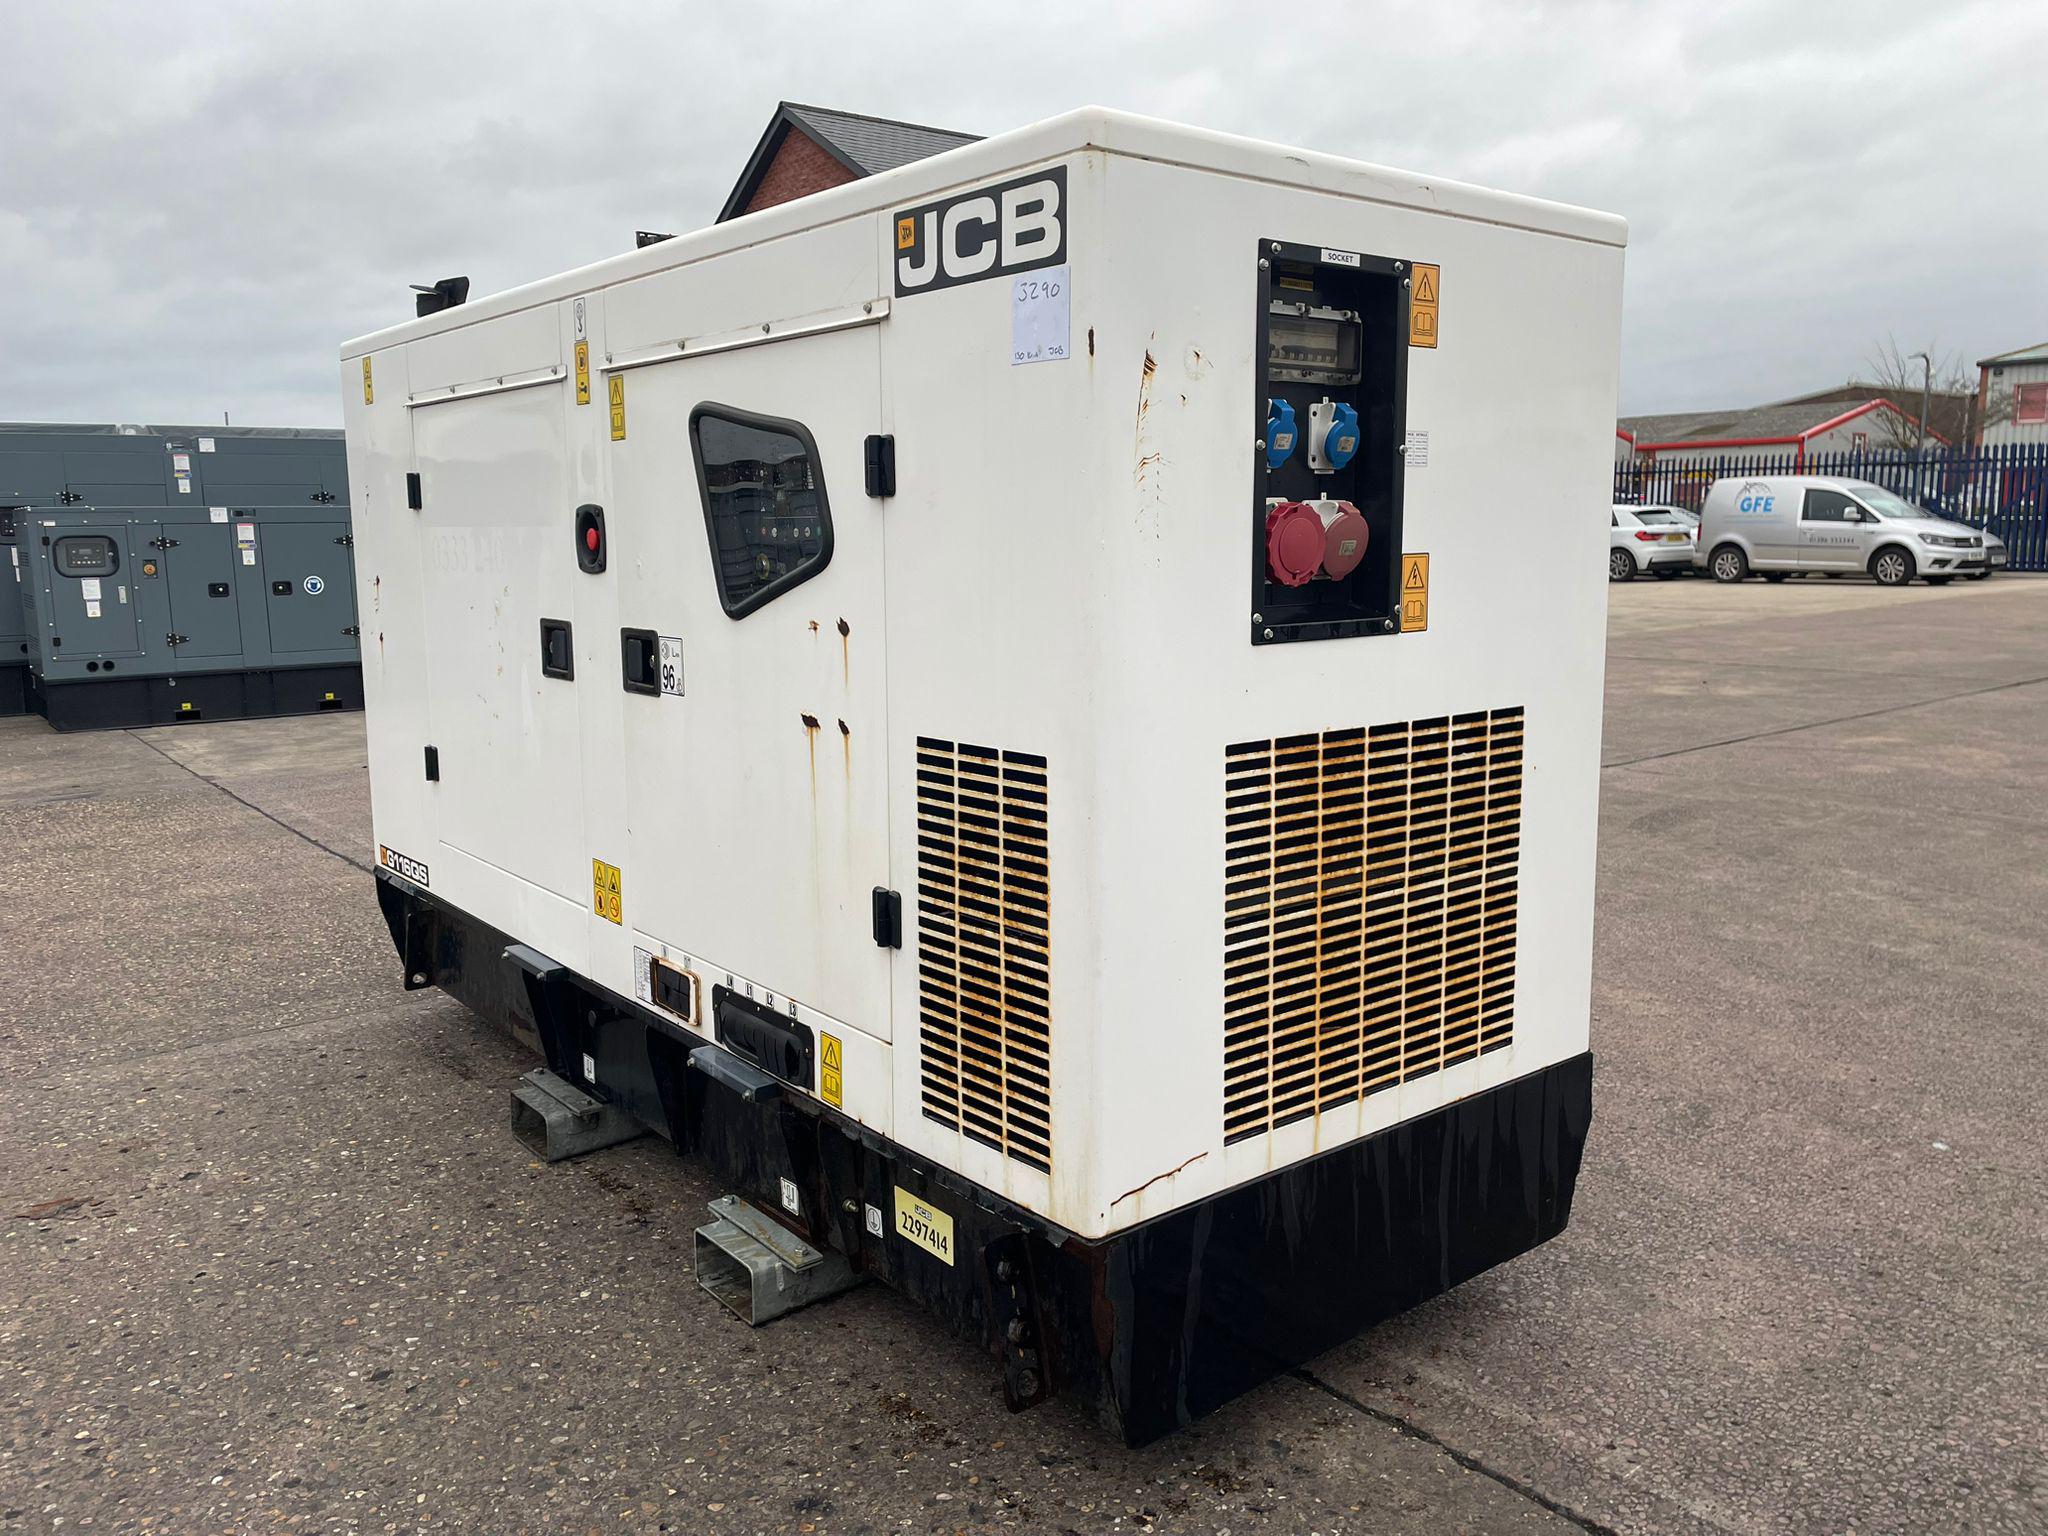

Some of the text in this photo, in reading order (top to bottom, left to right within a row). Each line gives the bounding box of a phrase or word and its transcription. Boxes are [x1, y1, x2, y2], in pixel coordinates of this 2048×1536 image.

[898, 179, 1061, 288] JCB
[1328, 252, 1354, 264] SOCKET
[1740, 495, 1775, 513] GFE
[662, 663, 676, 691] 96
[914, 1204, 933, 1221] JCB
[901, 1211, 948, 1255] 2297414
